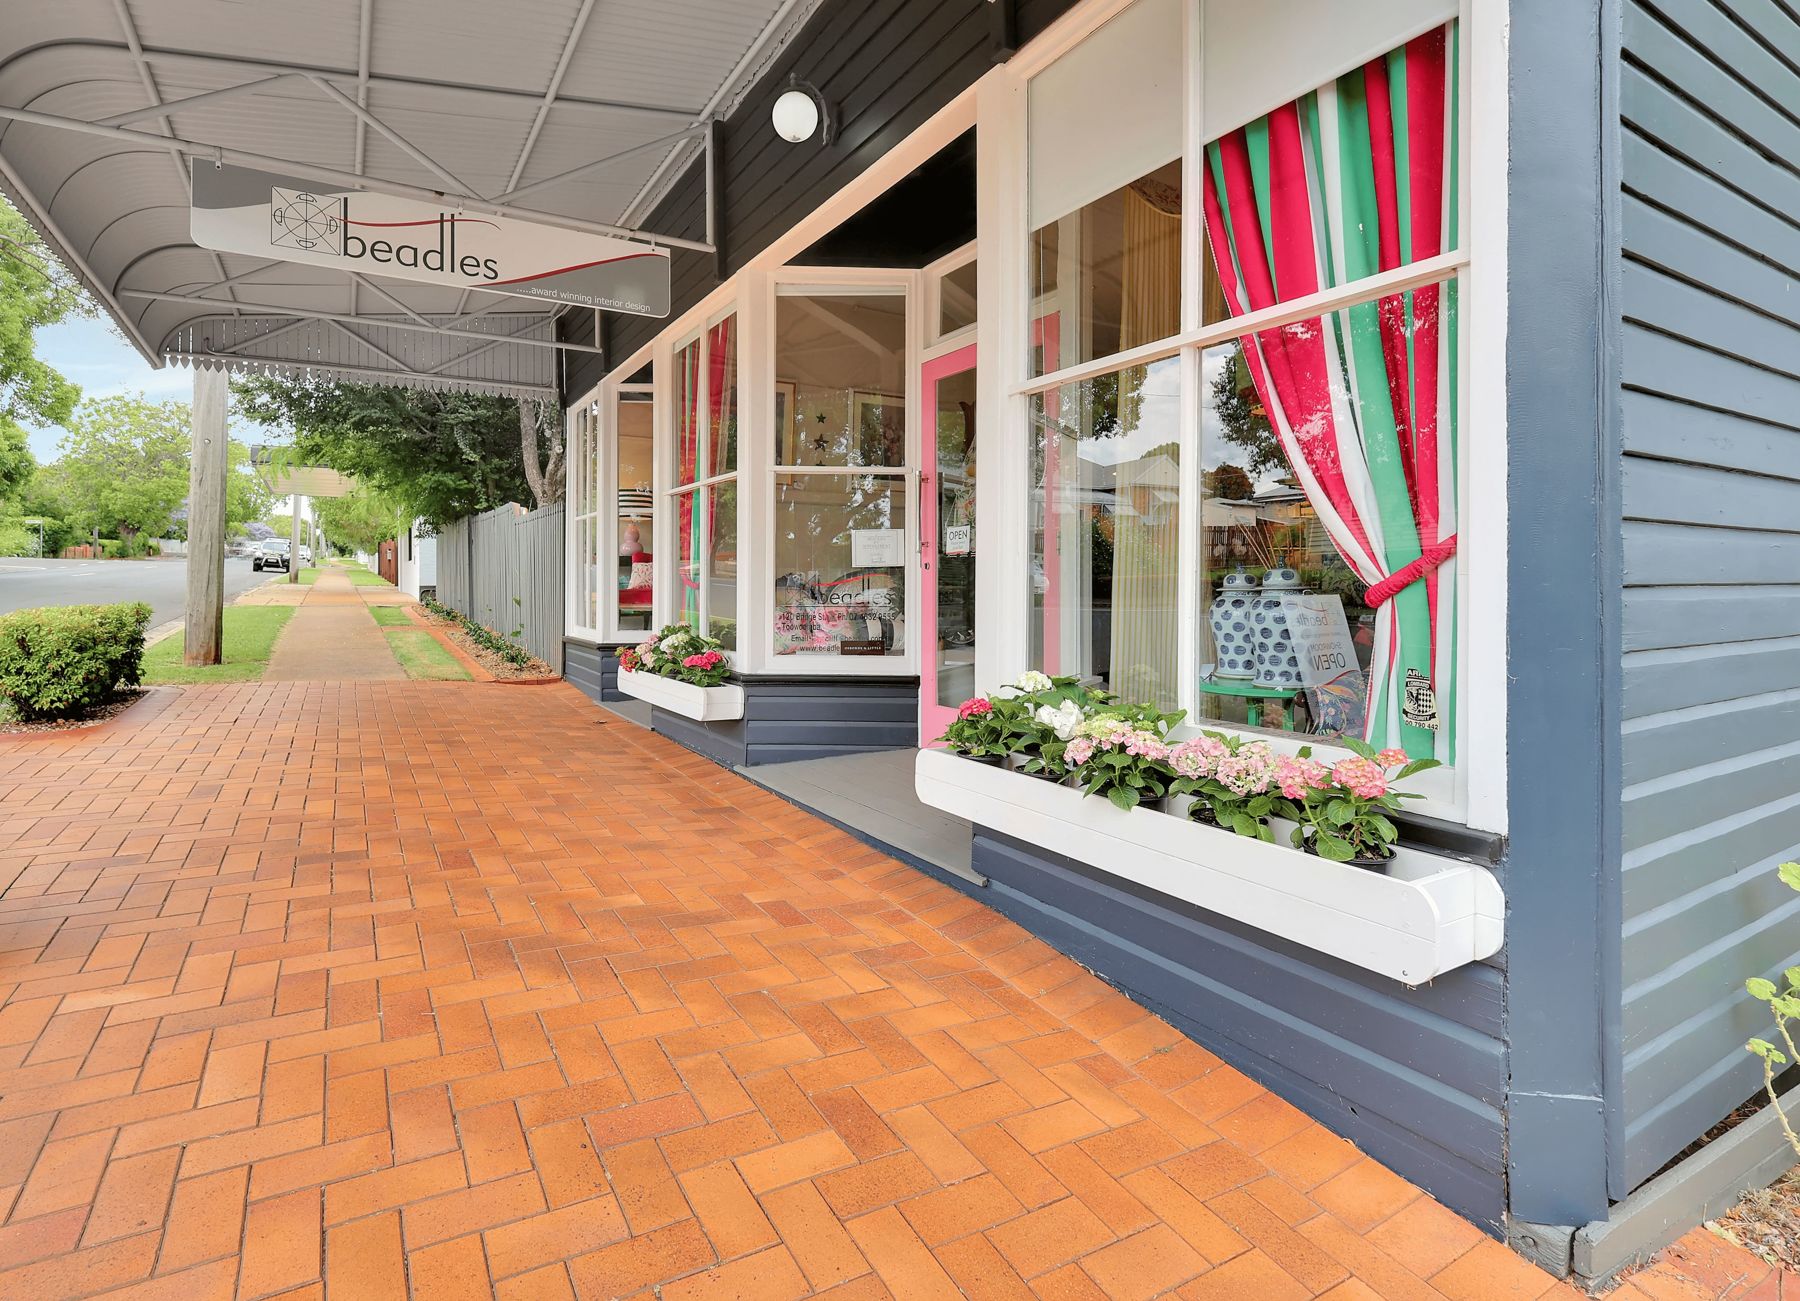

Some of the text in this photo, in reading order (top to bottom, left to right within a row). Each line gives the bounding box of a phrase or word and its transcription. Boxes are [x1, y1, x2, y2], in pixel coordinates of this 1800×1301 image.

[343, 196, 499, 280] beadles
[559, 291, 592, 304] winning
[594, 295, 623, 307] interior
[624, 301, 651, 312] design
[948, 529, 968, 541] OPEN
[817, 574, 892, 605] beadles
[1406, 711, 1430, 721] SECURITY
[1414, 721, 1426, 729] 790
[1426, 723, 1439, 731] 442
